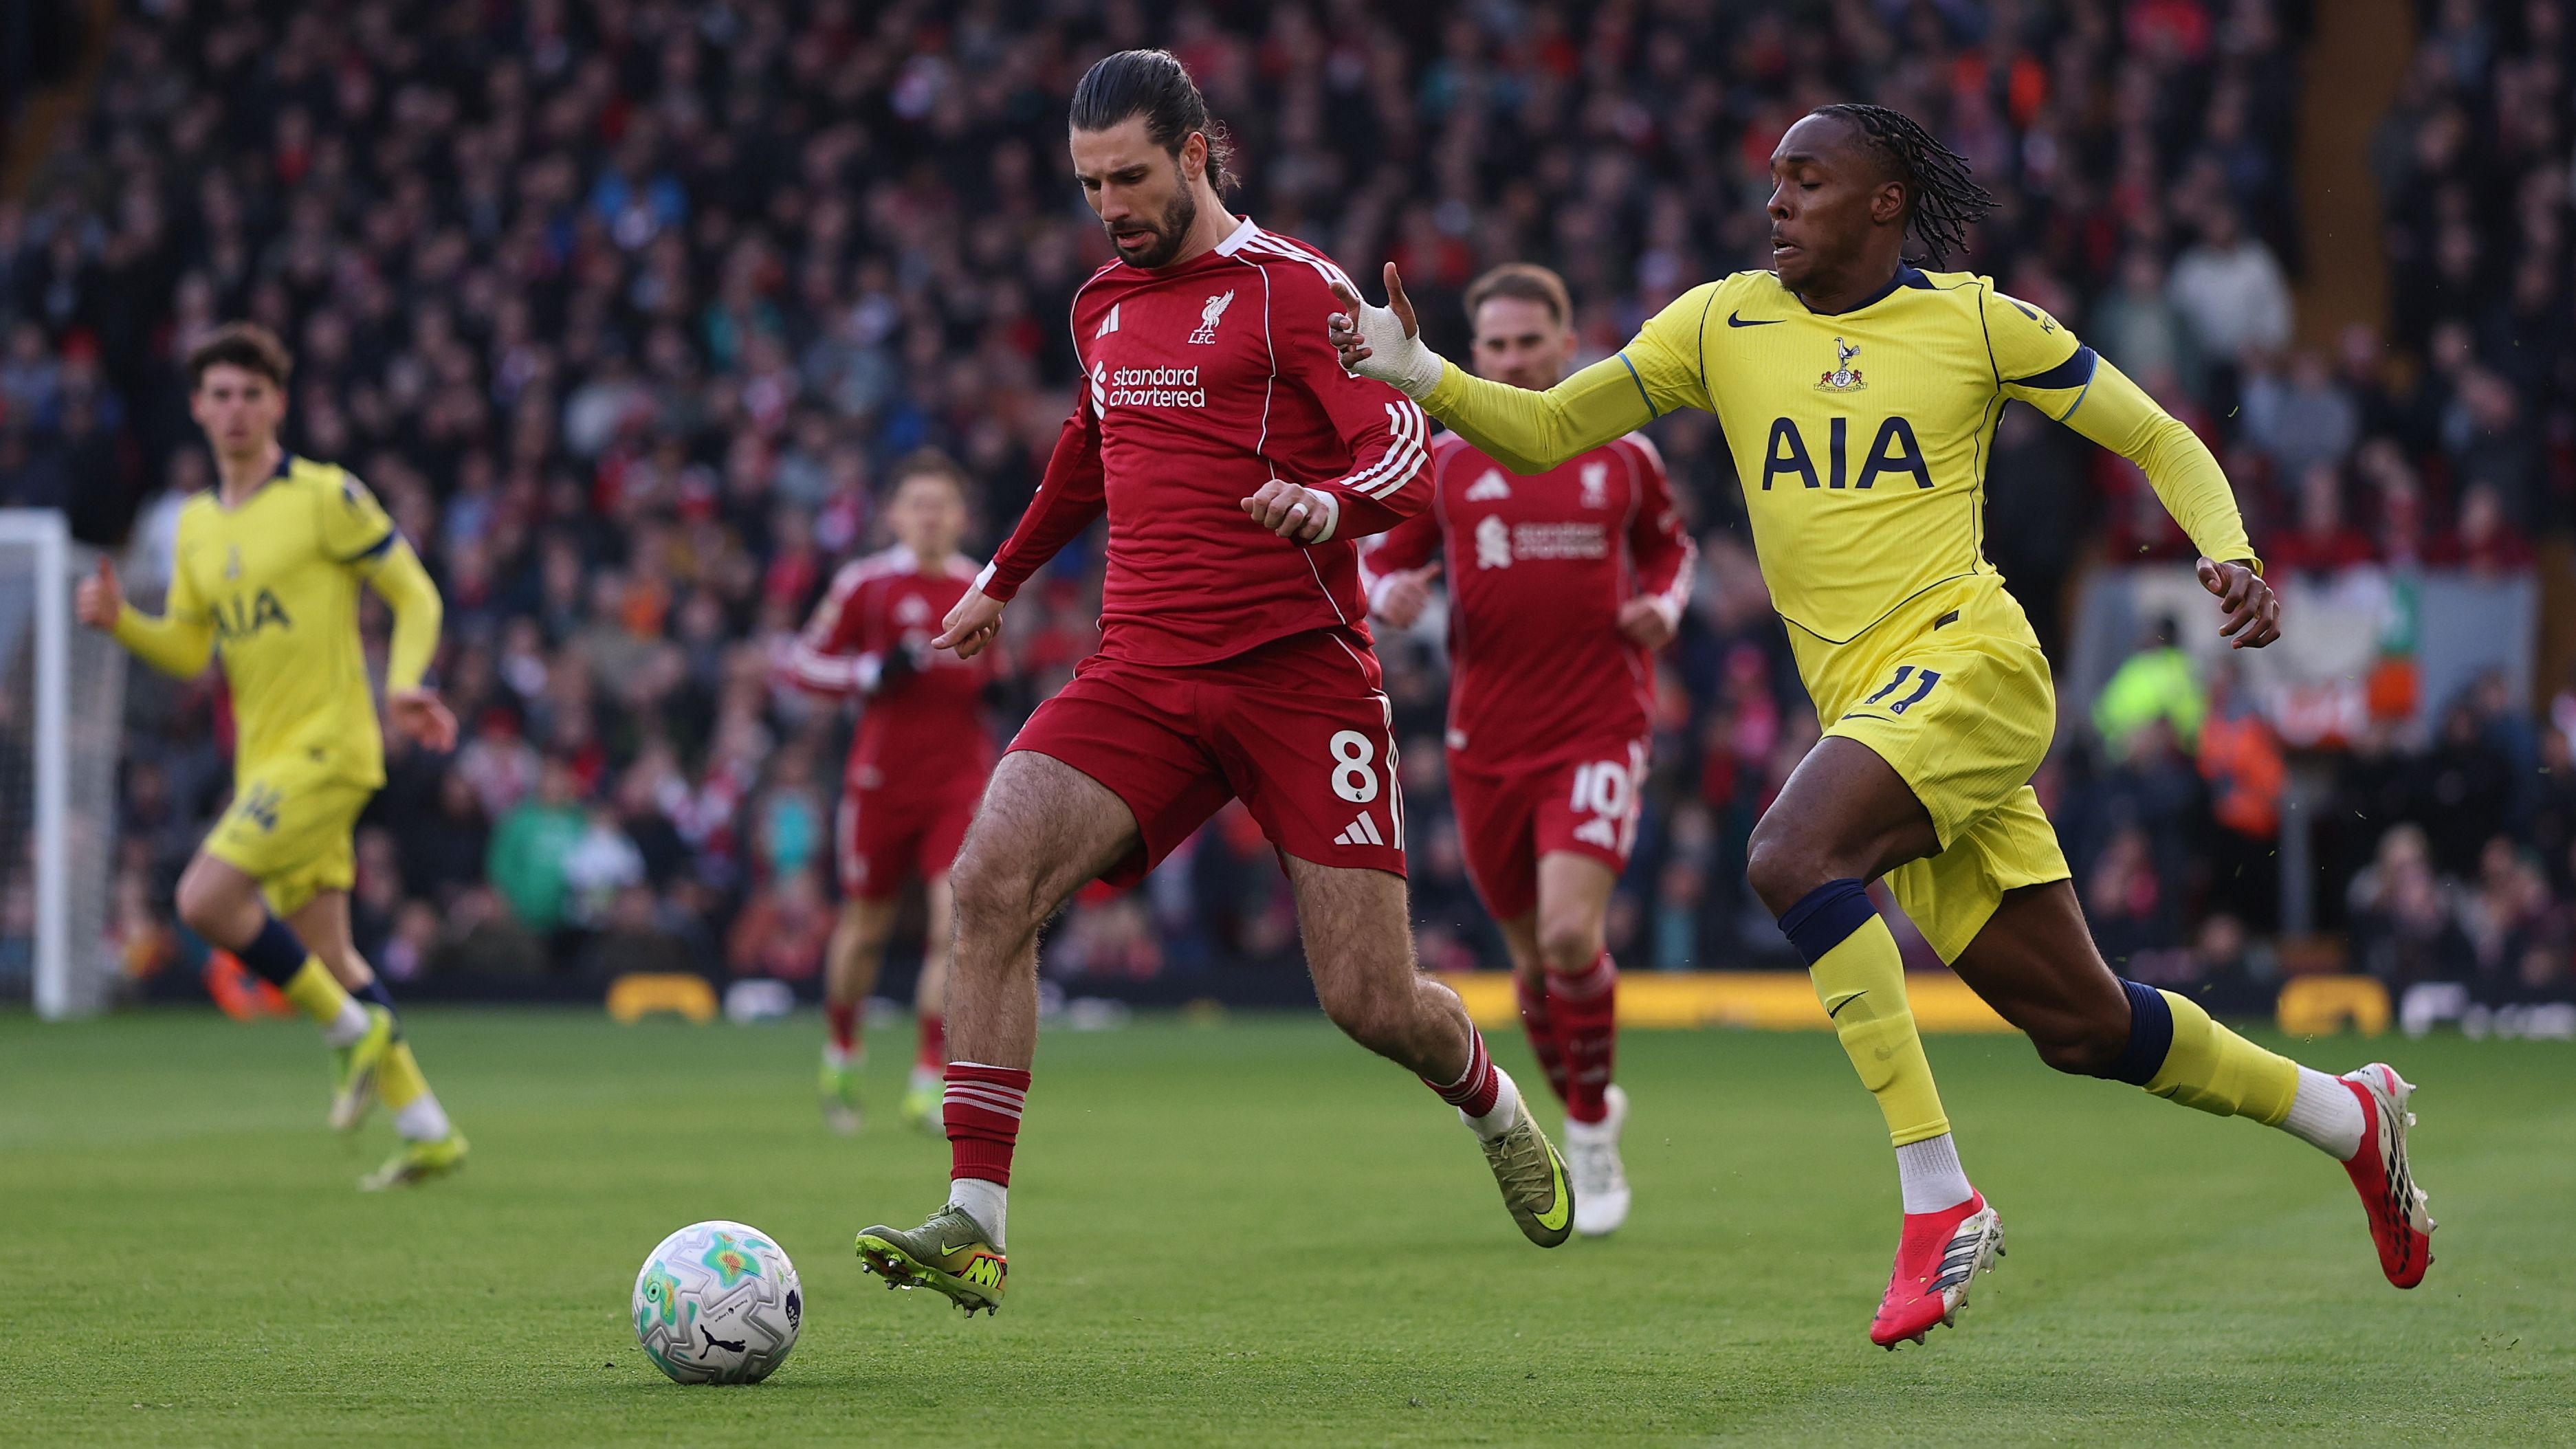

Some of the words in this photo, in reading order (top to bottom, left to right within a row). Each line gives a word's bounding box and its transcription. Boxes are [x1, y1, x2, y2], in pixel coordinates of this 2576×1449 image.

[1109, 386, 1205, 408] chartered
[1112, 364, 1198, 386] standard
[1761, 416, 1935, 491] AIA
[1330, 730, 1378, 803] 8
[1571, 760, 1628, 817] 10
